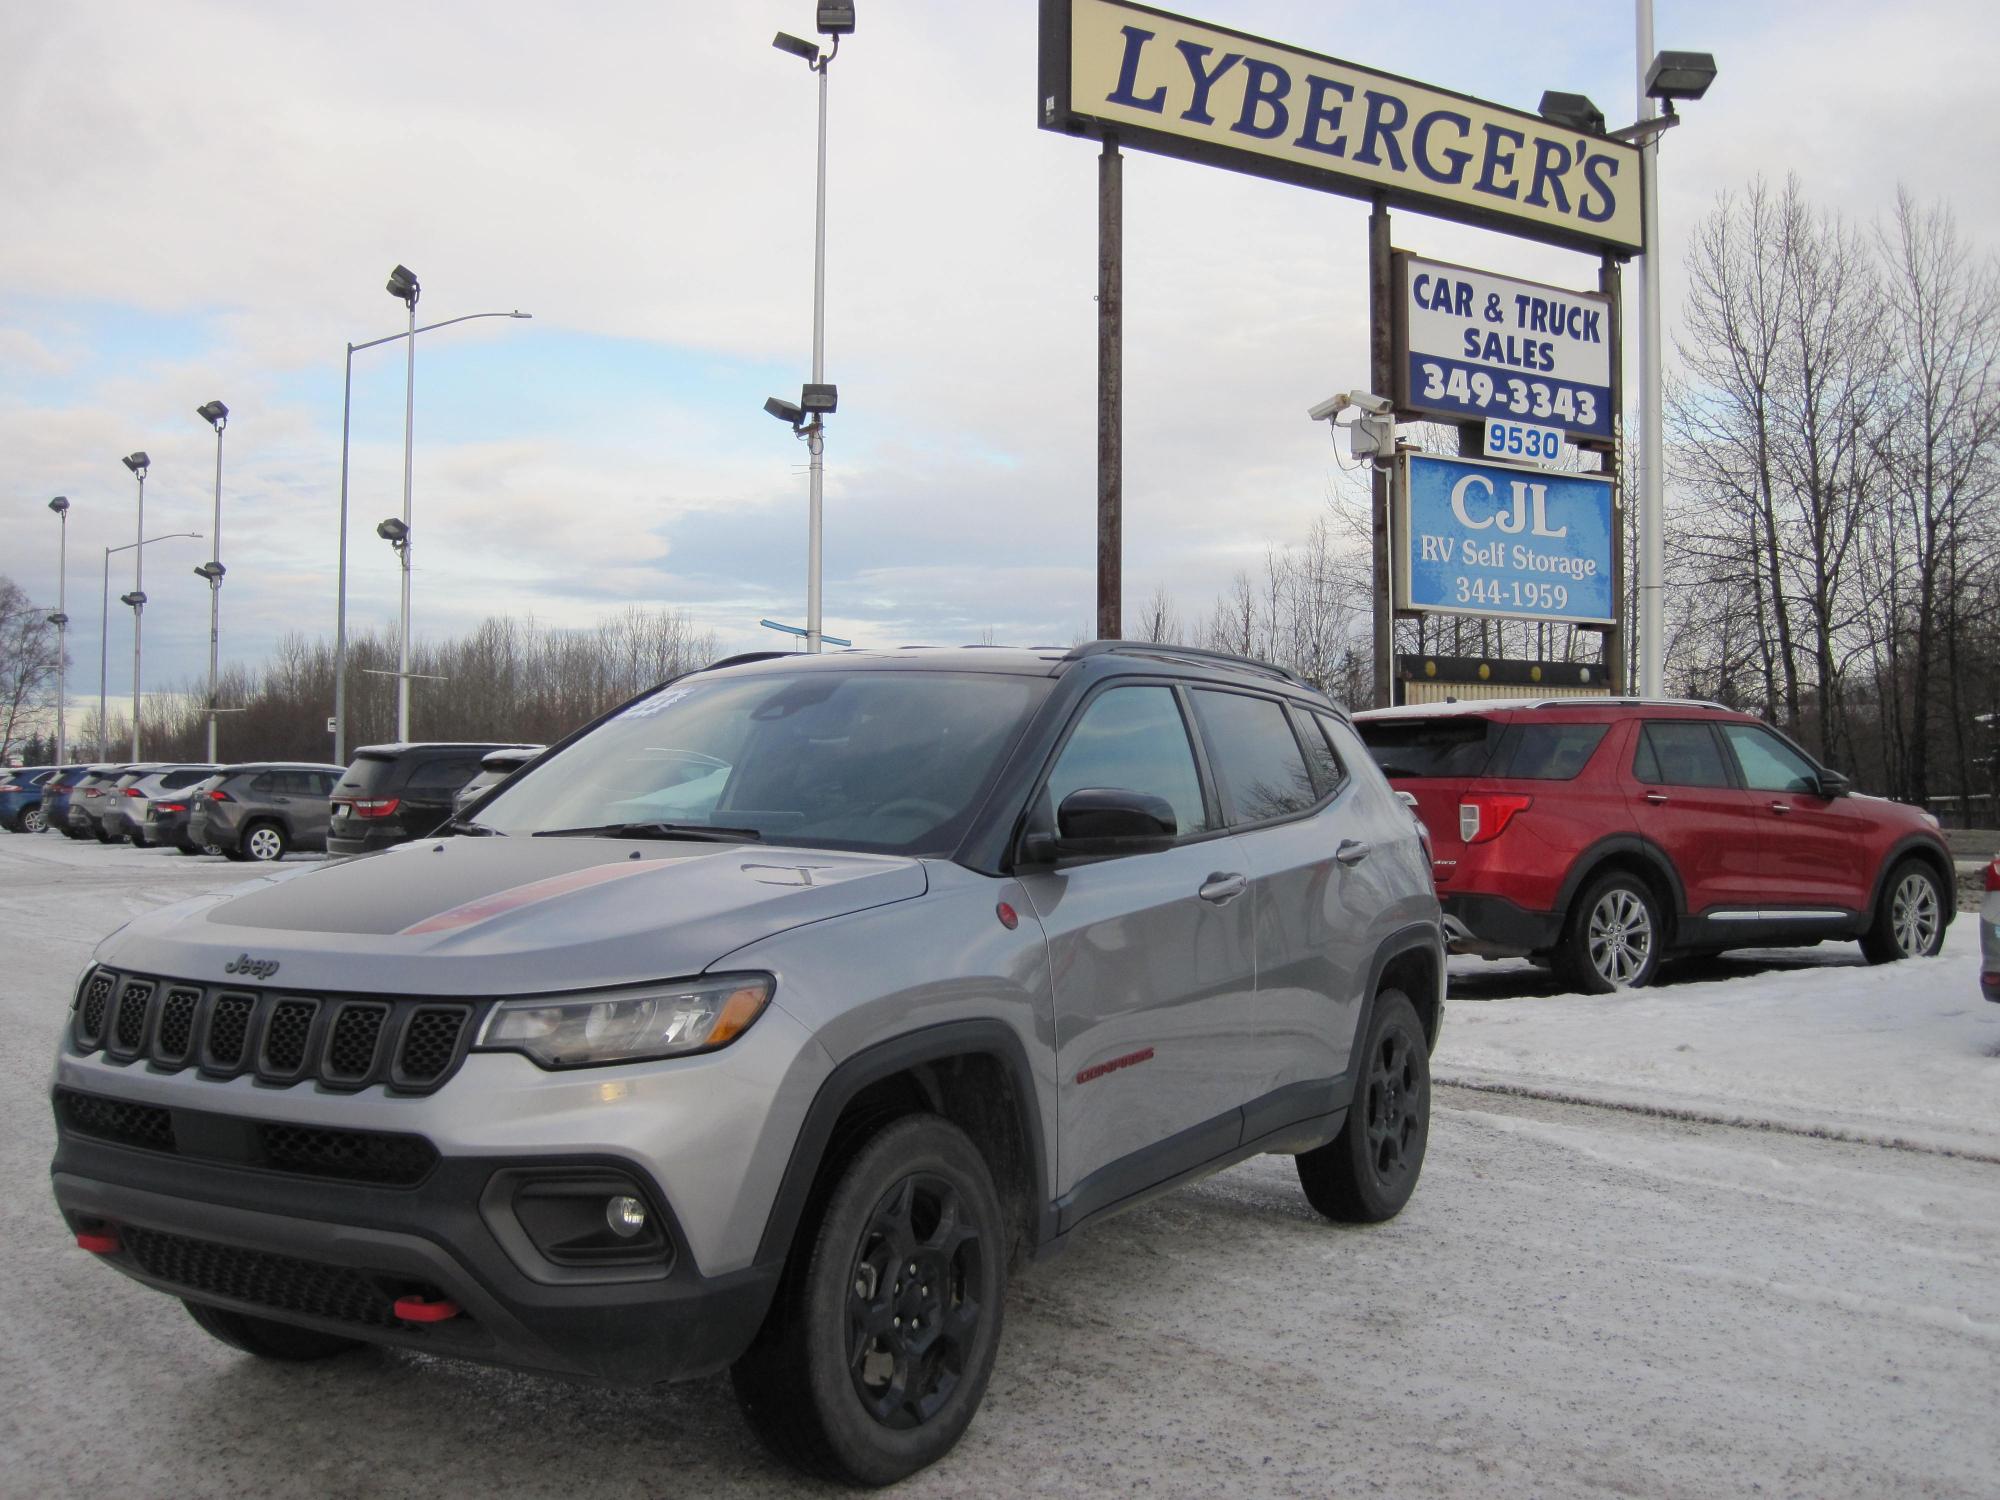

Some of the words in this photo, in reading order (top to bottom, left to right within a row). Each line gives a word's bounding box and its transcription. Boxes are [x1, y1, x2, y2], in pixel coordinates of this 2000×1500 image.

[1106, 25, 1619, 223] LYBERGER'S
[1413, 274, 1474, 317] CAR
[1484, 293, 1505, 324] &
[1515, 294, 1600, 343] TRUCK
[1464, 328, 1555, 371] SALES
[1424, 364, 1596, 425] 349-3343
[1490, 424, 1559, 459] 9530
[1451, 475, 1567, 537] CJL
[1421, 536, 1455, 562] RV
[1462, 541, 1505, 568] Self
[1512, 546, 1596, 580] Storage
[1456, 577, 1568, 609] 344-1959
[226, 954, 280, 980] Jeep
